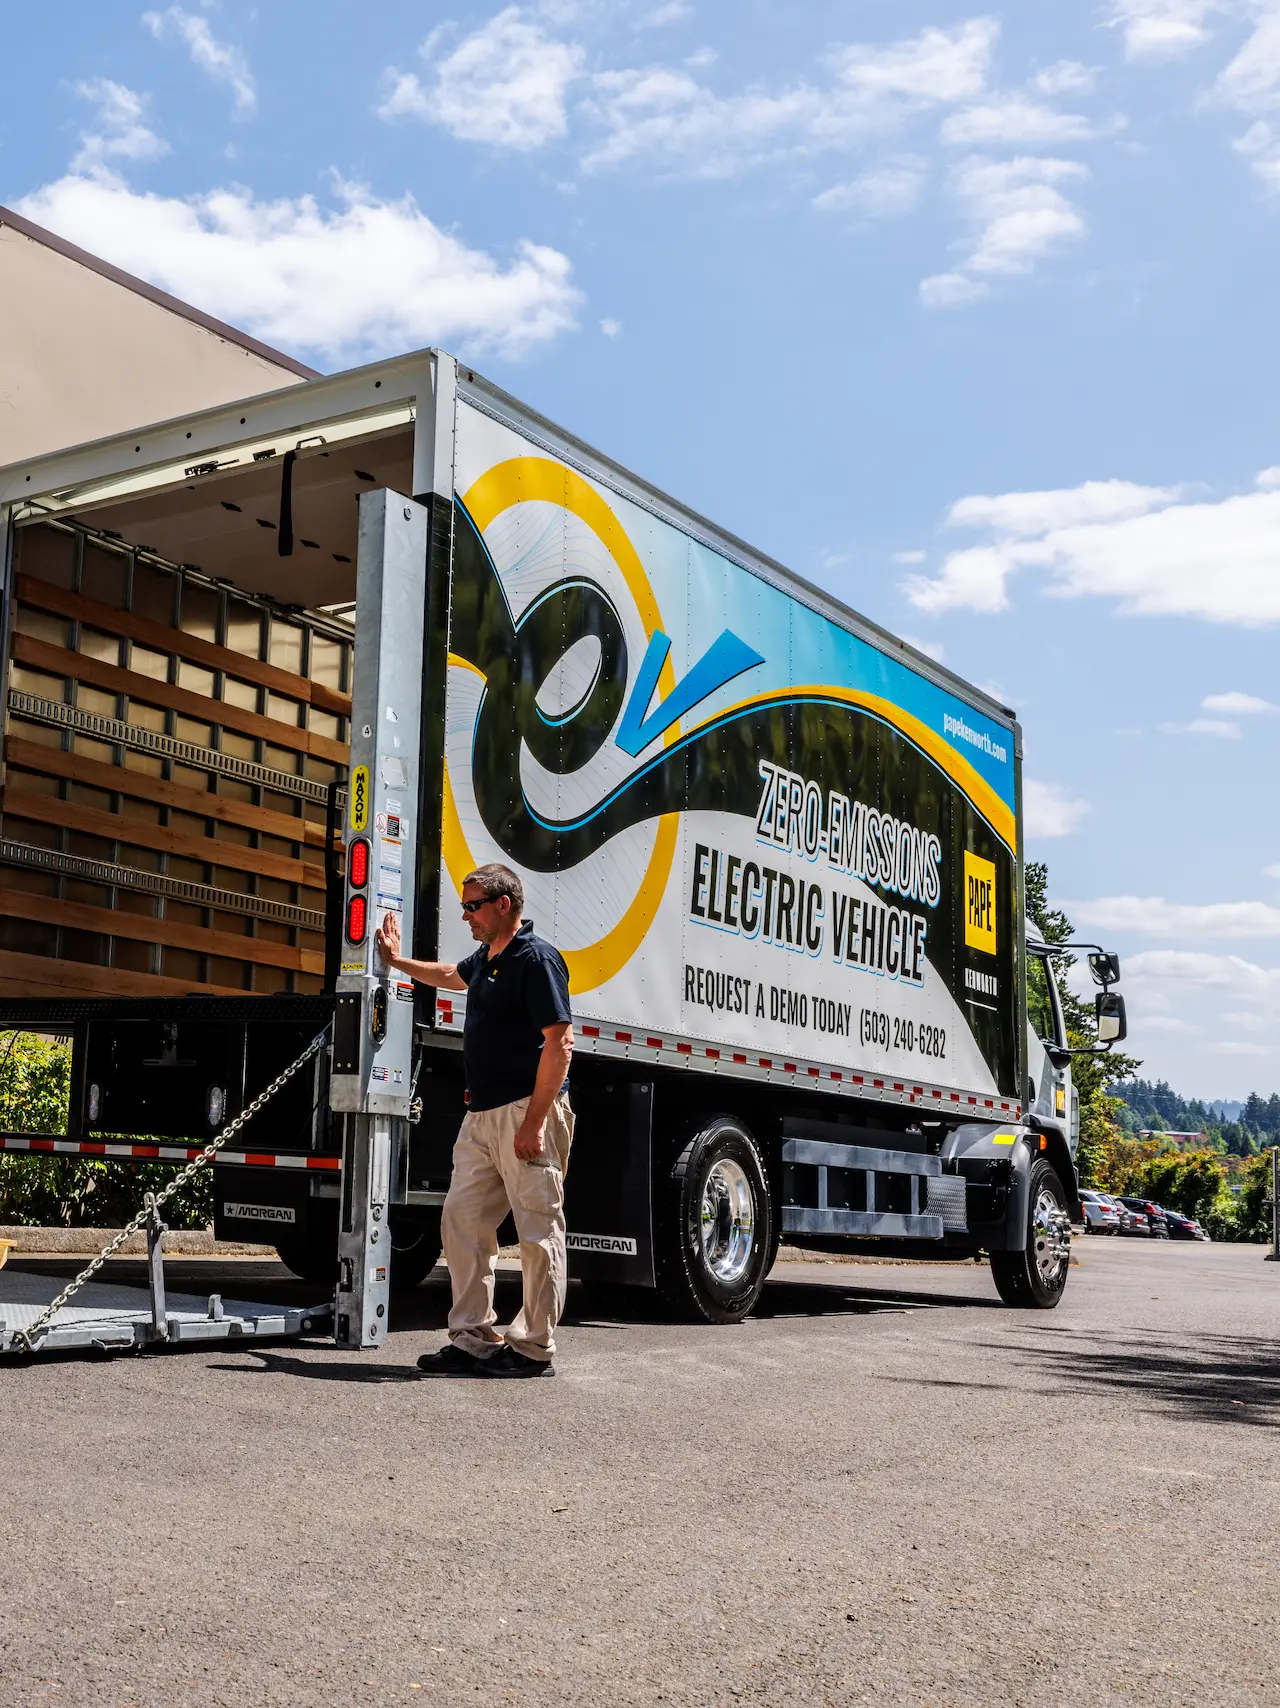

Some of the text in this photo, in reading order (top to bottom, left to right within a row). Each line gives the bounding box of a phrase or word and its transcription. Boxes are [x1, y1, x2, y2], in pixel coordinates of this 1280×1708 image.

[364, 726, 370, 735] 4
[943, 712, 1007, 764] papekenworth.com
[354, 772, 366, 824] MAXON
[690, 843, 927, 986] ELECTRIC VEHICLE
[964, 967, 998, 997] KENWORTH
[685, 964, 946, 1059] REQUEST A DEMO TODAY (503) 240-6282
[238, 1206, 292, 1221] MORGAN
[566, 1235, 632, 1252] MORGAN
